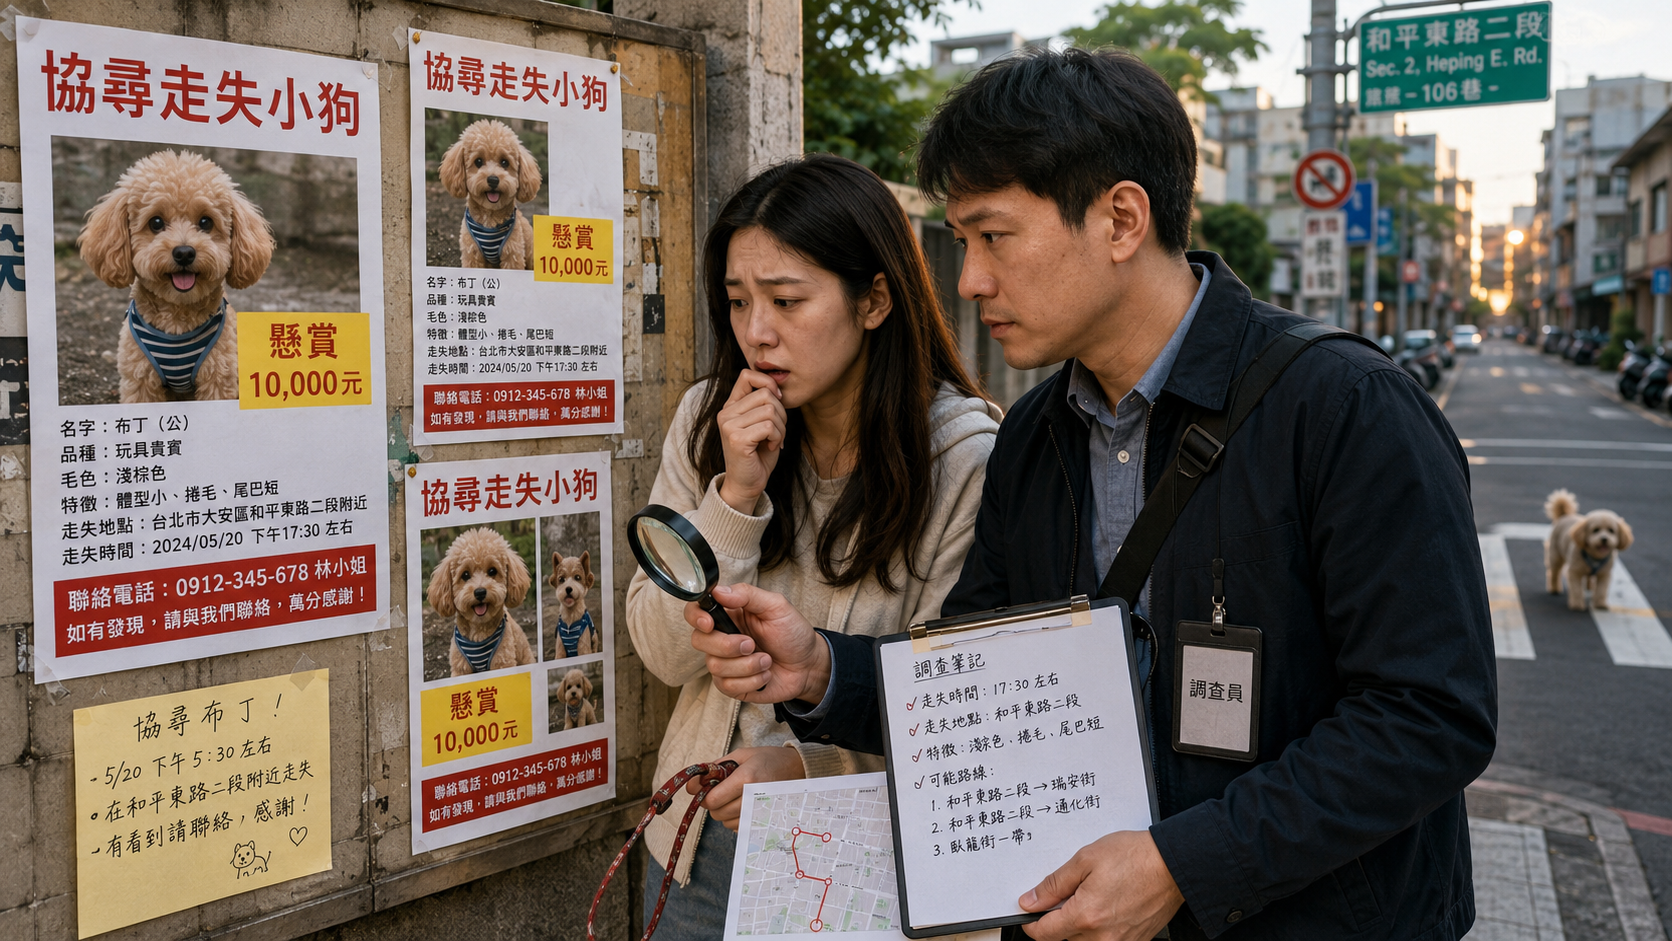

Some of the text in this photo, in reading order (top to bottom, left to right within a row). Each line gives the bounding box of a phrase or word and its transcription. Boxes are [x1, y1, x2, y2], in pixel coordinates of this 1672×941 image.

[1366, 11, 1543, 53] 和平東路二段
[1366, 46, 1543, 78] Sec. 2, Heping E. Rd.
[41, 49, 360, 137] 協尋走失小狗
[423, 50, 608, 112] 協尋走失小狗
[552, 223, 593, 250] 懸賞
[540, 256, 608, 277] 10,000元
[269, 322, 338, 360] 懸賞
[536, 361, 578, 373] 下午17:30
[581, 361, 598, 372] 左右
[249, 370, 363, 401] 10,000元
[575, 386, 608, 401] 林小姐
[421, 468, 598, 517] 協尋走失小狗
[251, 523, 320, 544] 下午17:30
[325, 519, 353, 536] 左右
[314, 555, 367, 580] 林小姐
[1034, 672, 1059, 689] 左右
[1189, 679, 1243, 703] 調查員
[450, 686, 498, 721] 懸賞
[433, 720, 518, 754] 10,000元
[153, 752, 185, 777] 下午
[192, 747, 235, 768] 5:30
[240, 736, 271, 759] 左右
[571, 747, 602, 766] 林小姐
[104, 760, 314, 823] 在和平東路二段附近走失
[947, 782, 1031, 809] 和平東路二段
[1051, 772, 1096, 791] 瑞安街
[949, 805, 1034, 833] 和平東路二段
[1055, 795, 1100, 814] 通化街
